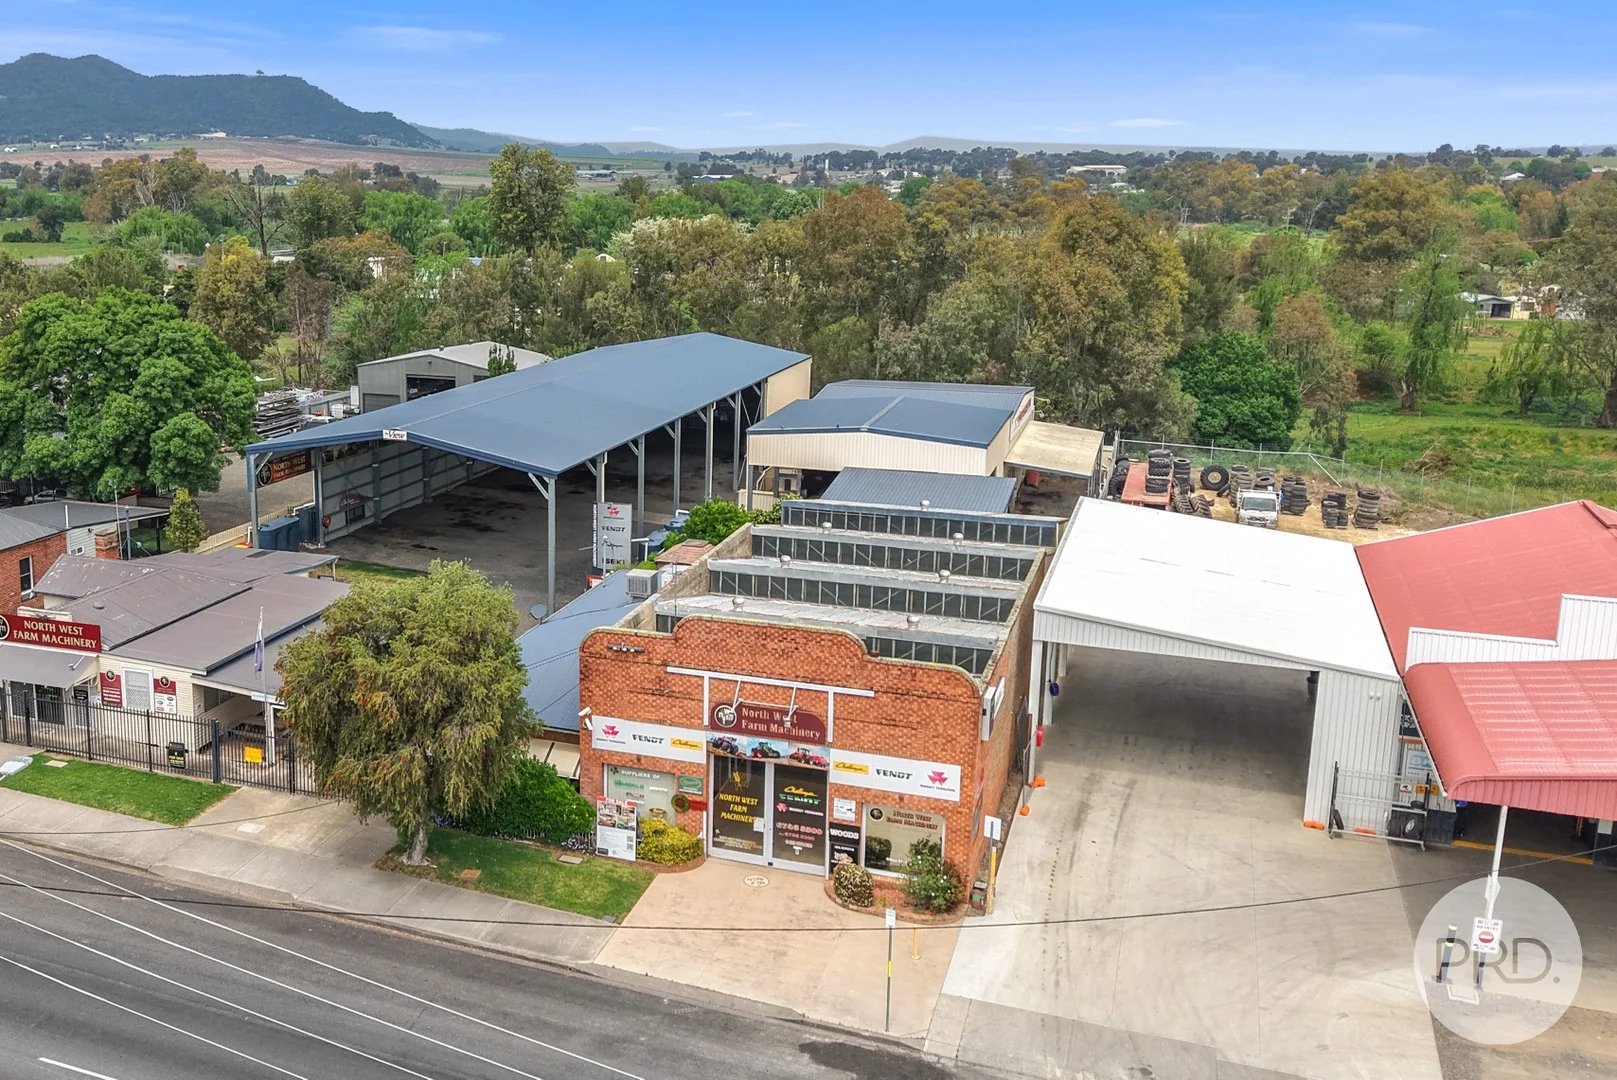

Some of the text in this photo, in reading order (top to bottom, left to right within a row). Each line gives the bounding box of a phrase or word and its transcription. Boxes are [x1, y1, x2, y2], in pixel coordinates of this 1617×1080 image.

[388, 430, 405, 440] View
[601, 525, 627, 533] FENDT
[24, 620, 84, 636] NORTH WEST
[13, 630, 97, 648] FARM MACHINERY
[741, 707, 798, 723] North Wt
[741, 719, 821, 740] Farm Machinery
[632, 734, 665, 744] FENDT
[621, 769, 651, 779] SUPPLIERS
[875, 768, 913, 780] FENDT
[719, 792, 759, 806] NORTH WEST
[730, 804, 748, 813] FARM
[829, 828, 860, 840] WOODS
